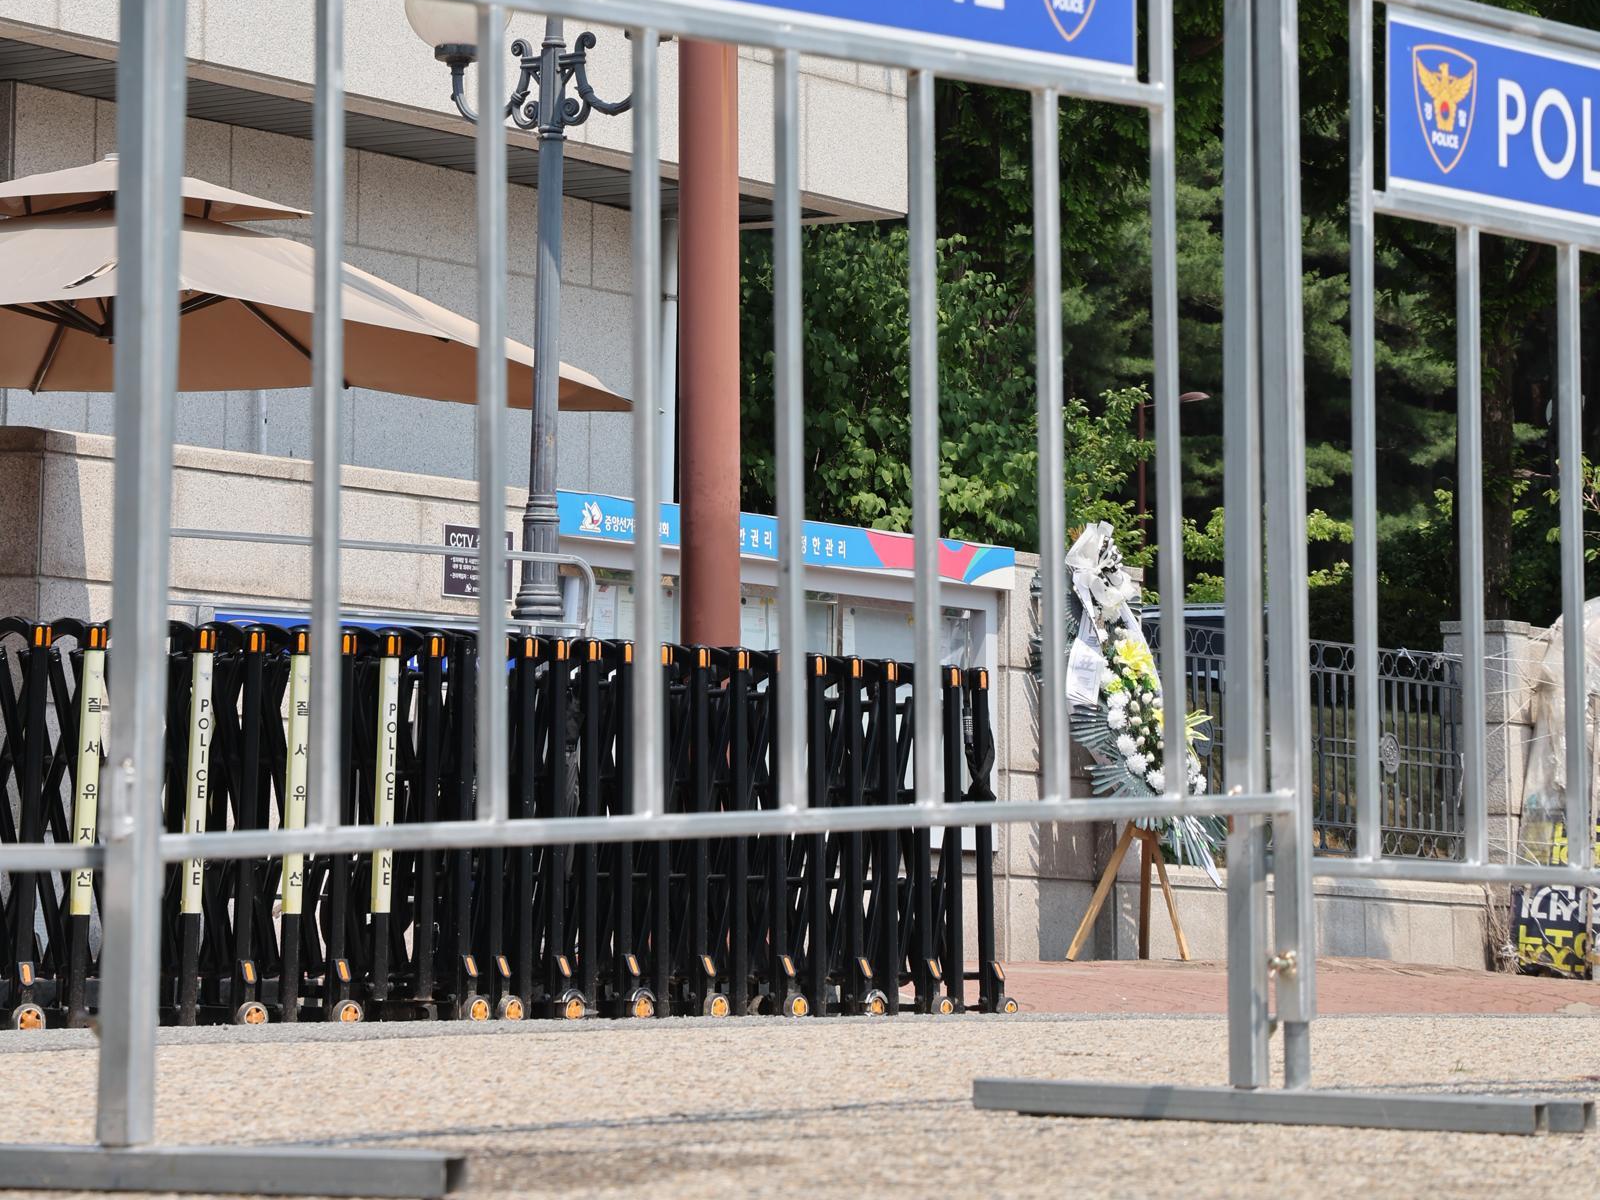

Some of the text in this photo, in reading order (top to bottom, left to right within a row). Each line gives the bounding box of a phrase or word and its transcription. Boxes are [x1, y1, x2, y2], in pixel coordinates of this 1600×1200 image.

[1431, 130, 1459, 150] POLICE
[450, 532, 474, 548] CCTV
[385, 703, 397, 800] POLICE
[192, 699, 210, 886] POLICE LNE
